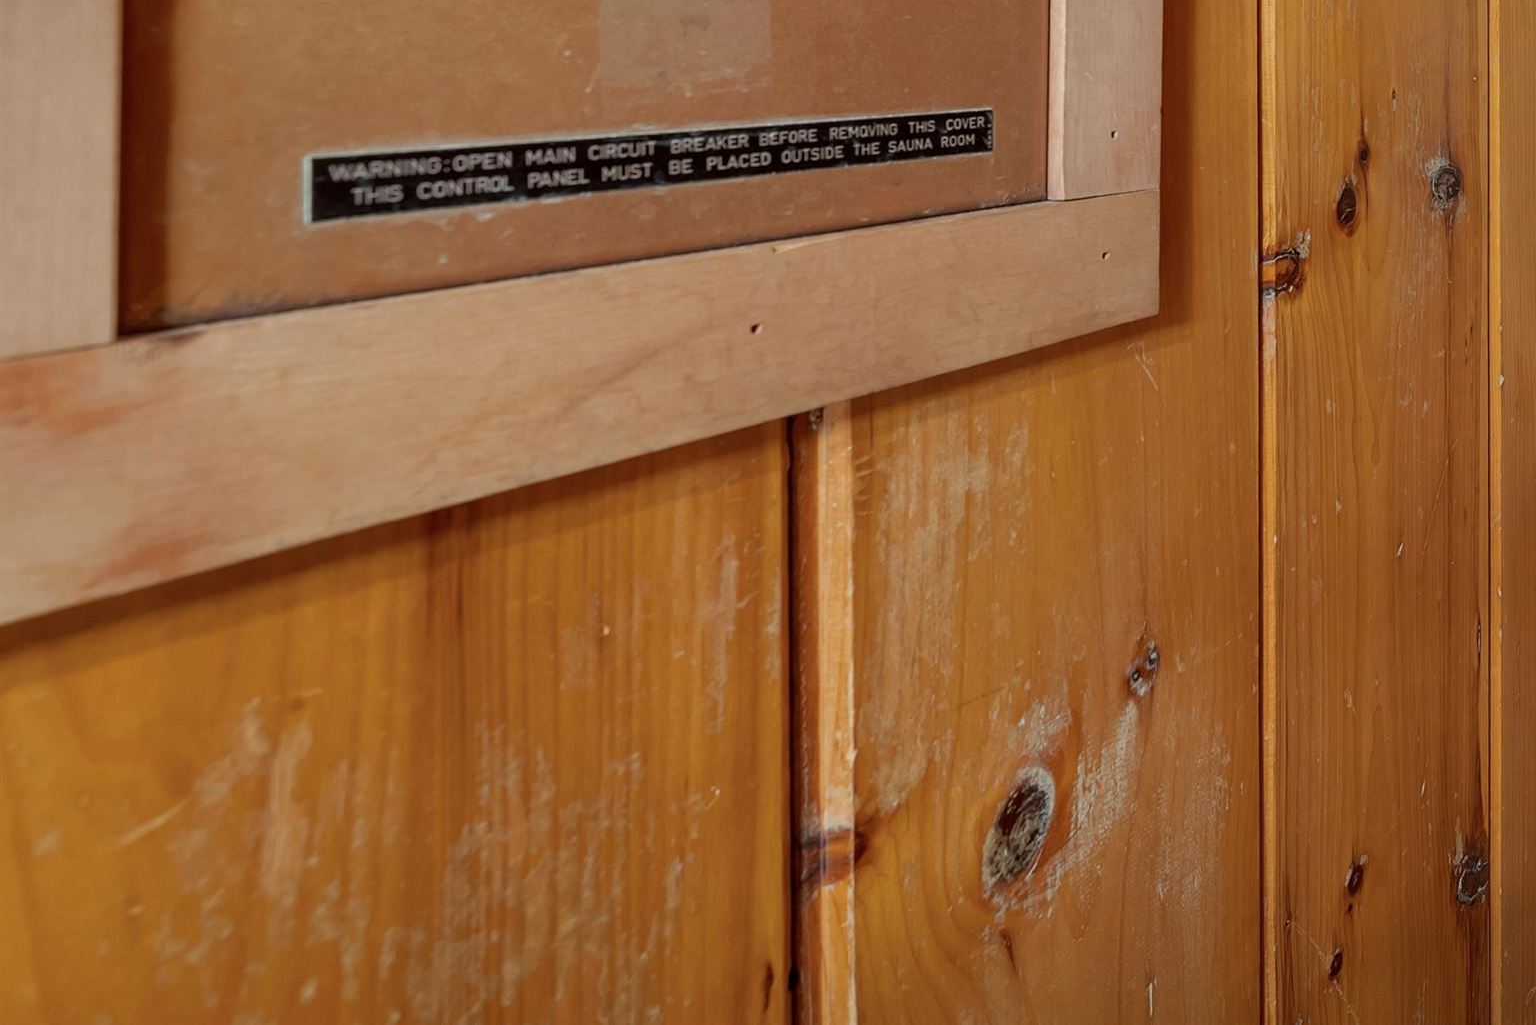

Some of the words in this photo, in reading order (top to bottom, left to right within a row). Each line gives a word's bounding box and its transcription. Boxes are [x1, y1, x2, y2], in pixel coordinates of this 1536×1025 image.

[350, 183, 405, 207] THIS
[415, 175, 515, 201] CONTROL
[527, 168, 591, 190] PANEL
[600, 161, 654, 183] MUST
[668, 158, 694, 177] BE
[705, 151, 773, 172] PLACED
[780, 145, 845, 164] OUTSIDE
[852, 141, 881, 158] THE
[887, 137, 934, 154] SAUNA
[940, 134, 976, 149] ROOM
[525, 146, 577, 167] MAIN
[587, 140, 657, 161] CIRCUIT
[669, 133, 750, 155] BREAKER
[758, 128, 819, 147] BEFORE
[828, 122, 899, 141] REMOVING
[907, 119, 936, 134] THIS
